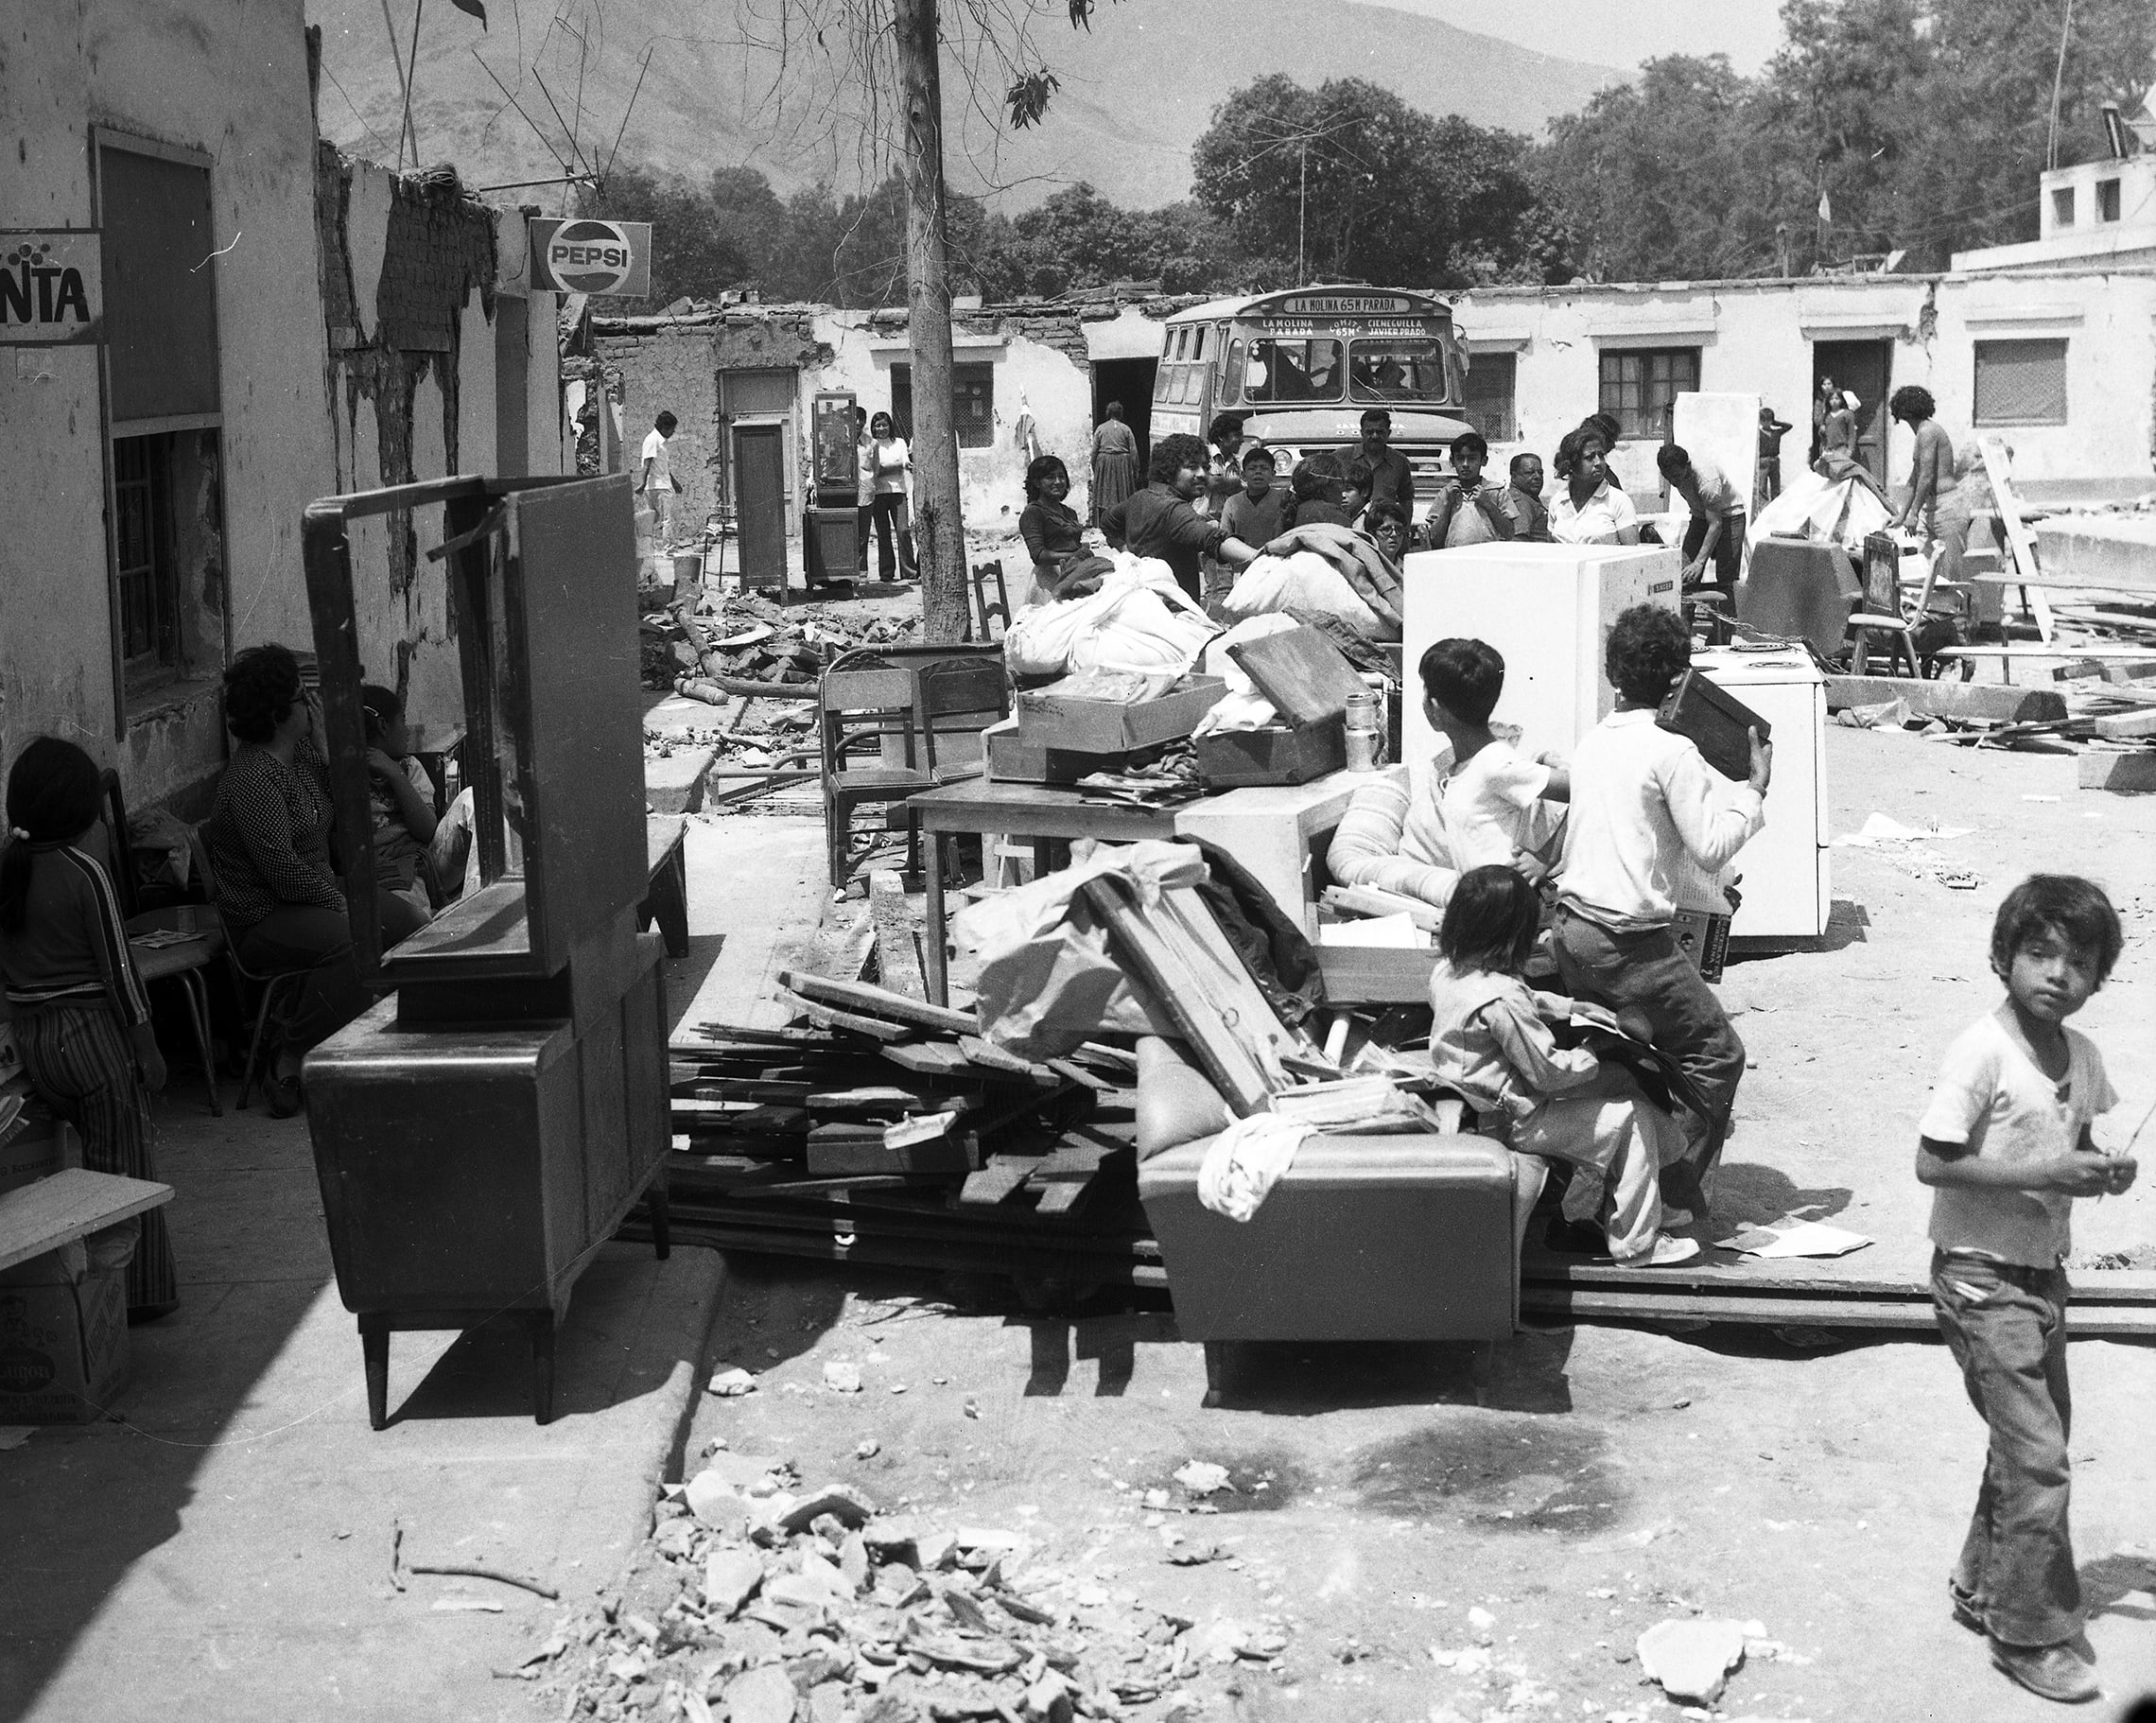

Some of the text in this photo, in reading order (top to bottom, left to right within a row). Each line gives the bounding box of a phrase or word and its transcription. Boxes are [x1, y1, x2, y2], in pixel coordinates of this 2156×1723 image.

[551, 245, 628, 268] PEPSI
[1295, 299, 1306, 312] LA
[1310, 299, 1339, 312] MOLINA
[1363, 299, 1396, 311] PARADA
[1276, 319, 1313, 327] MOLINA
[1330, 319, 1363, 333] COMITE
[1367, 319, 1422, 327] CIENEGUILLA
[1270, 327, 1313, 336] PARADA
[1368, 327, 1426, 337] JAVIER PRADO
